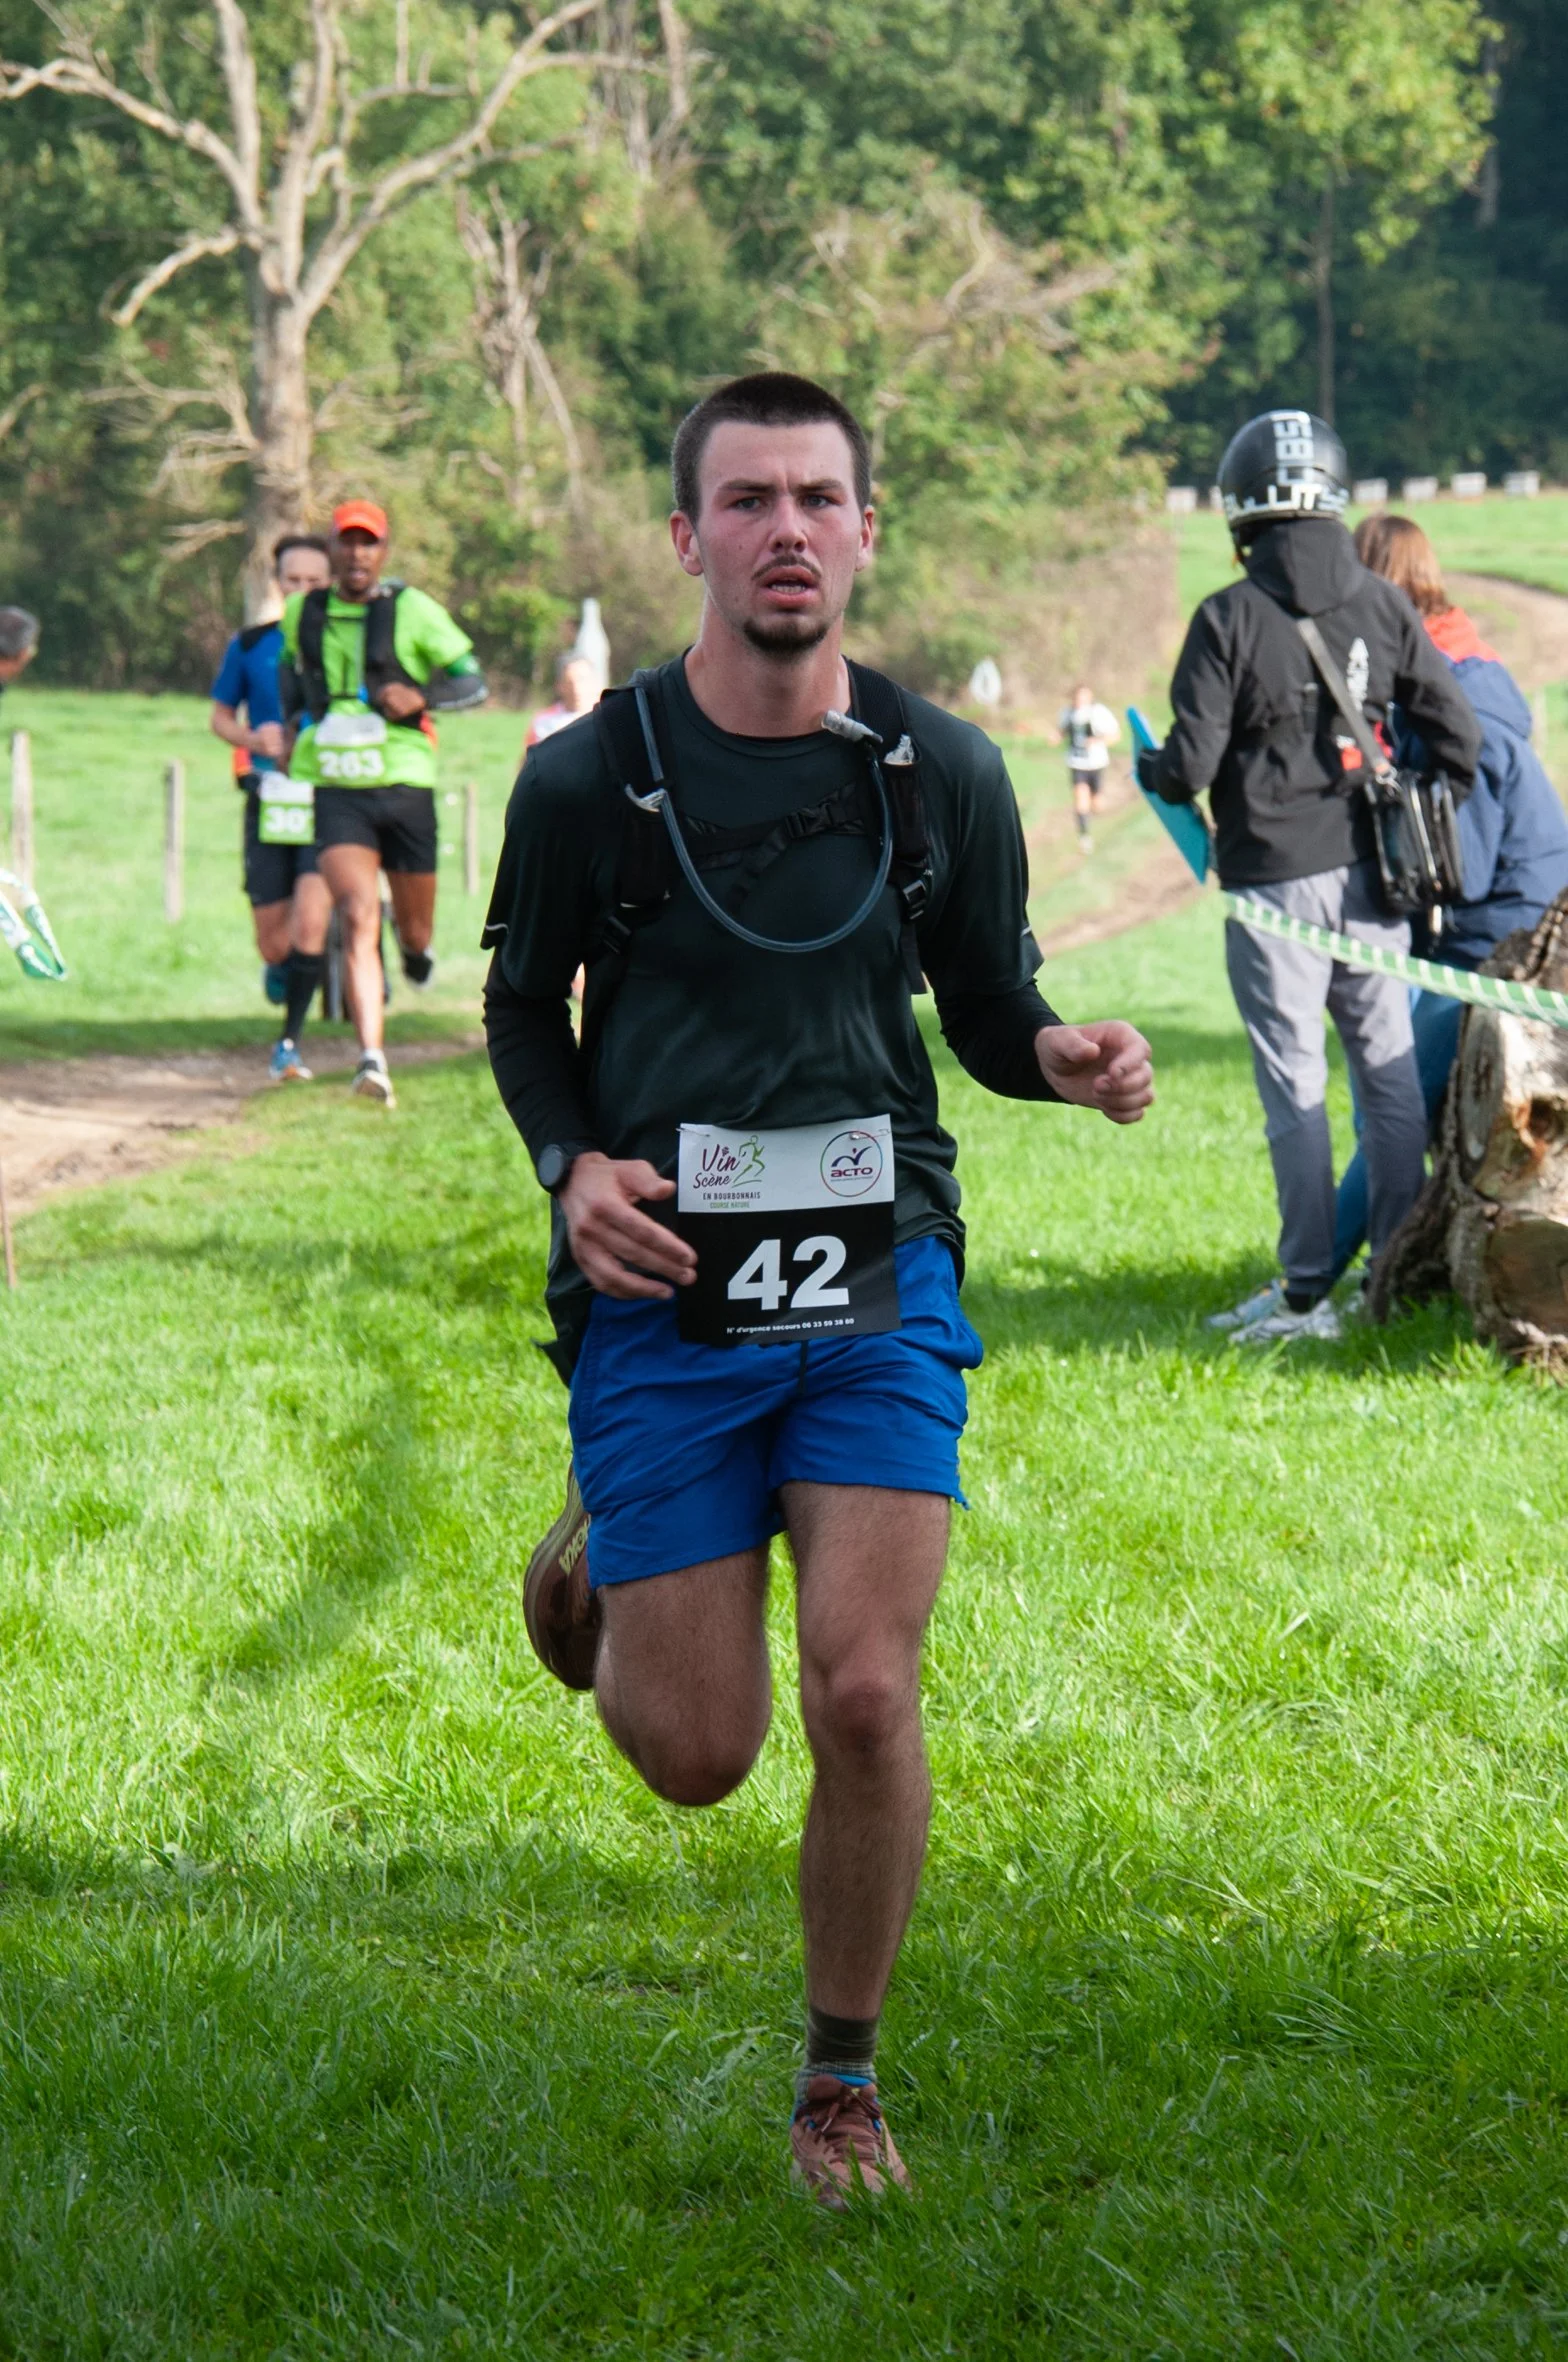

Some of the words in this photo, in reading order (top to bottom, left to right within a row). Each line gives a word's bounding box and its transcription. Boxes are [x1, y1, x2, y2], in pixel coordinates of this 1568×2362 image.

[693, 1172, 731, 1189] Scène
[713, 1192, 761, 1200] BOURBONNAIS
[727, 1235, 850, 1310] 42
[772, 1323, 801, 1331] secours
[812, 1320, 823, 1328] 33
